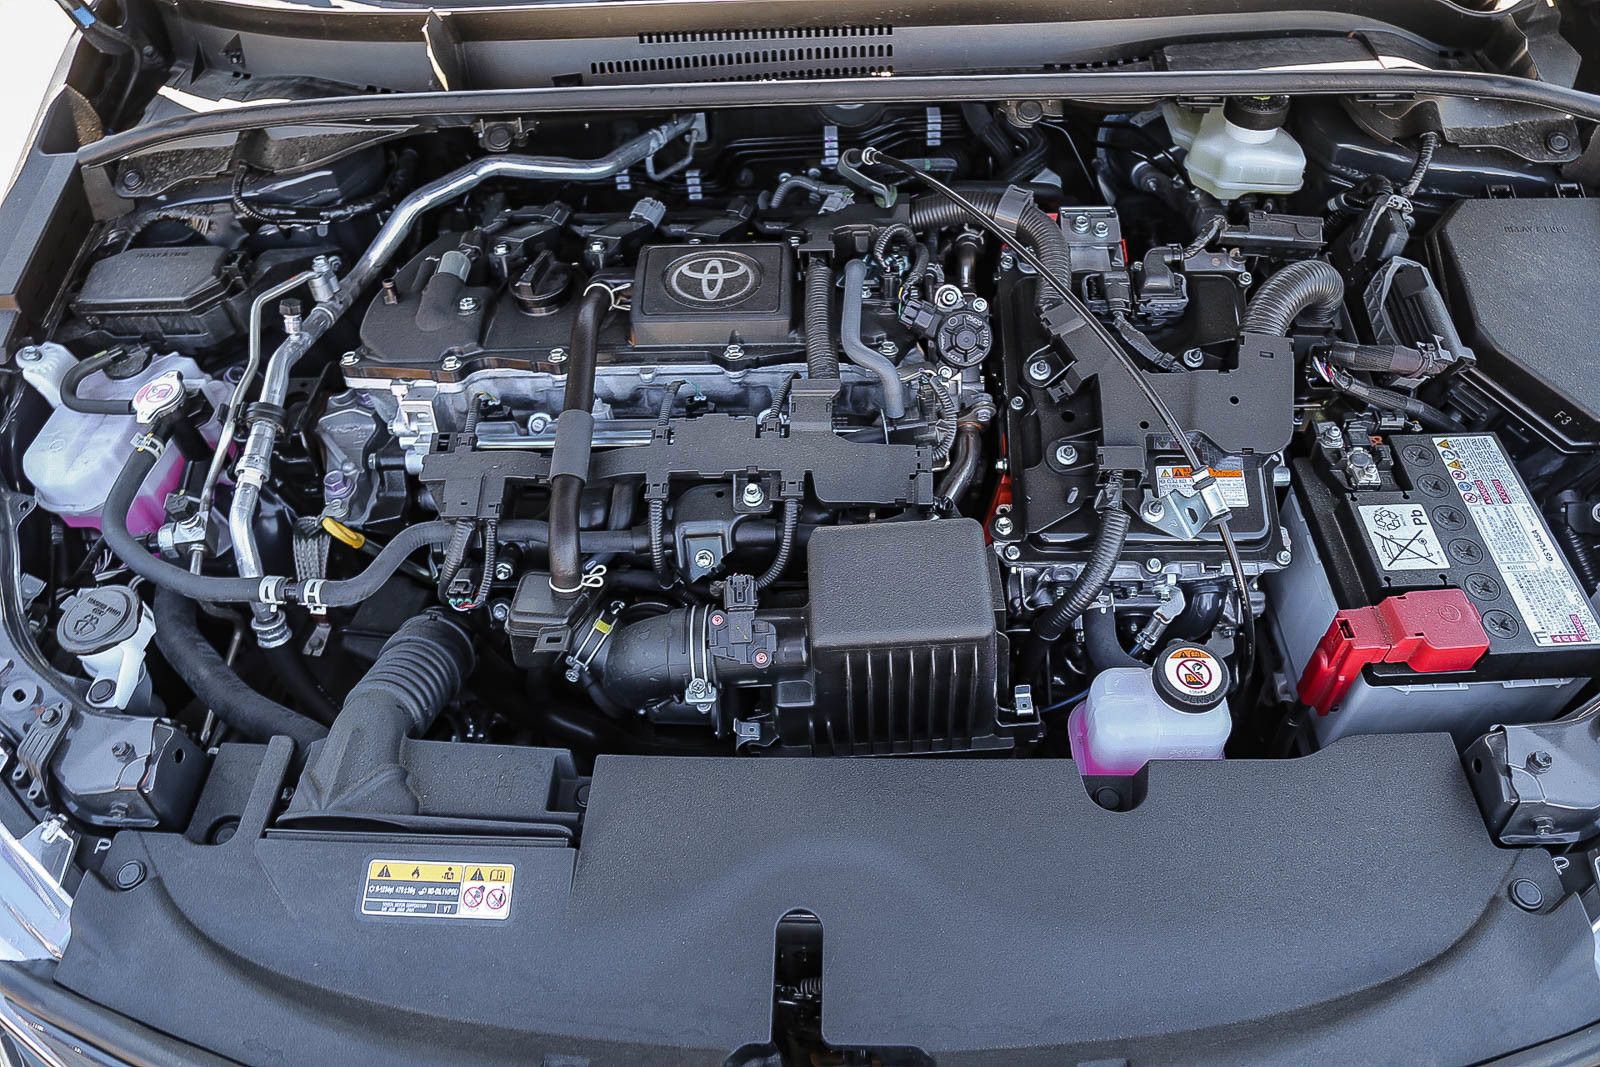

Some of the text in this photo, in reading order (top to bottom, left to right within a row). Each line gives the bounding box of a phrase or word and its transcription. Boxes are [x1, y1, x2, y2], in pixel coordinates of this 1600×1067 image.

[1554, 410, 1572, 425] F3
[1410, 510, 1427, 526] Pb
[1531, 530, 1554, 561] GS YUASA
[1183, 693, 1216, 704] DENSO
[93, 838, 112, 855] P
